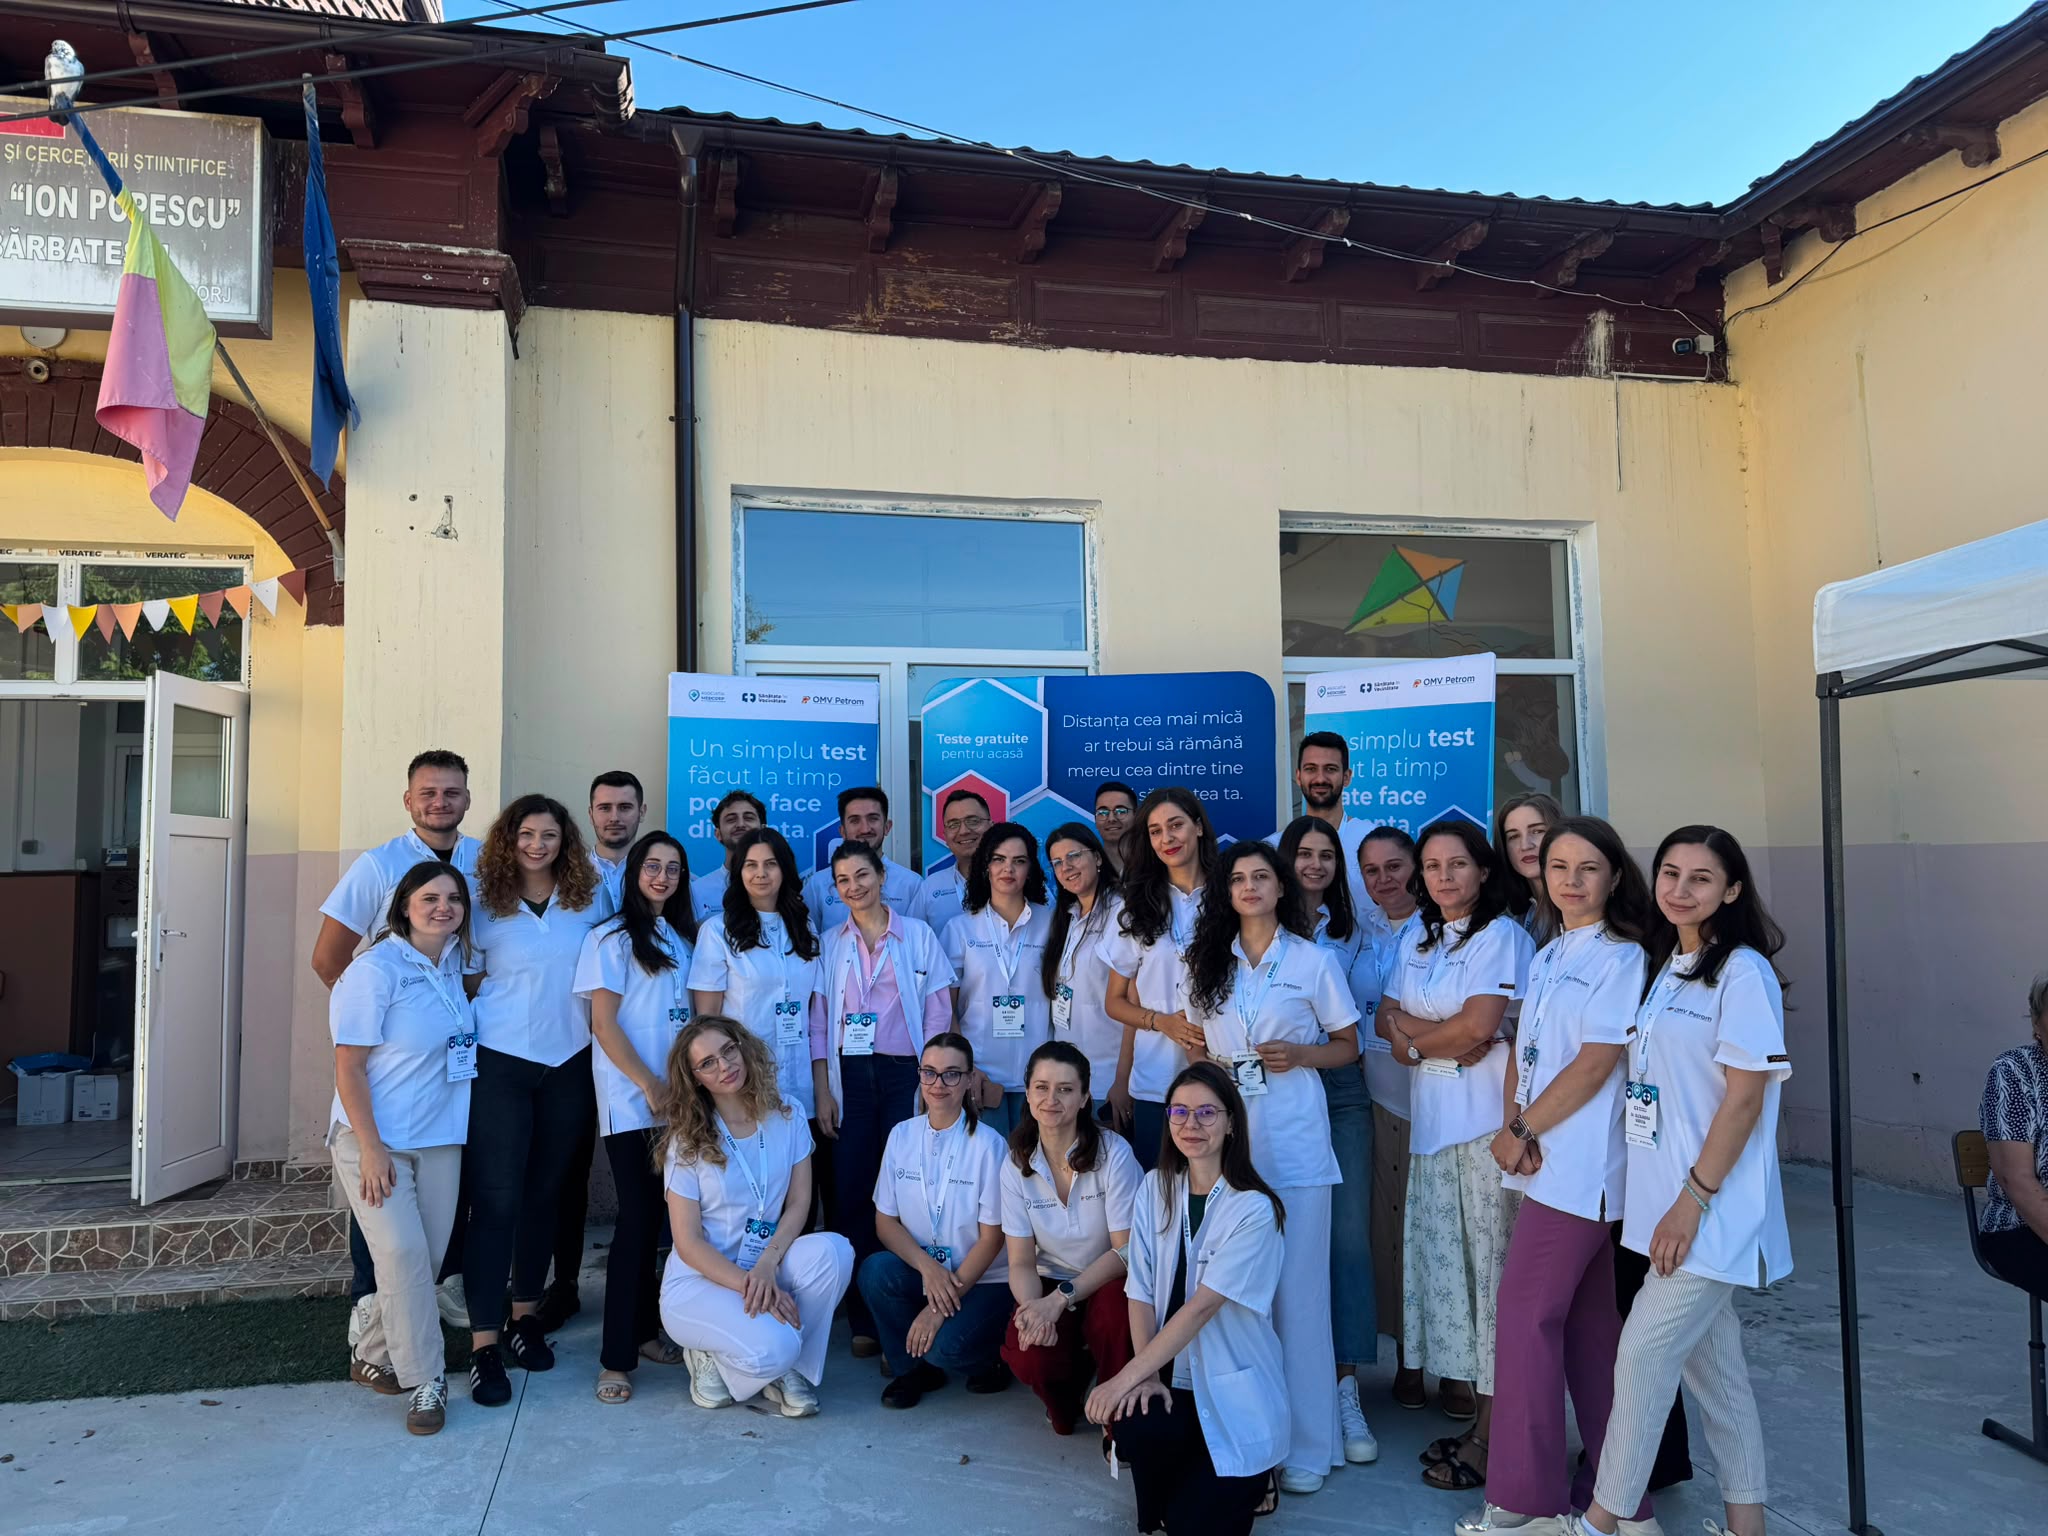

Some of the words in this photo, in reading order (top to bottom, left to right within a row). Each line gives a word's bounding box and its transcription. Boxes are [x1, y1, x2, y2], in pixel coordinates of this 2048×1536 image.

[190, 284, 232, 303] ORJ
[145, 551, 186, 559] VERATEC
[1423, 677, 1444, 687] OMV
[1445, 675, 1475, 685] Petrom
[812, 695, 833, 704] OMV
[834, 696, 865, 705] Petrom
[1063, 714, 1129, 731] Distanța
[1134, 715, 1162, 727] cea
[1166, 711, 1199, 726] mai
[1203, 710, 1243, 725] mică
[936, 733, 973, 746] Teste
[975, 732, 1029, 747] gratuite
[1084, 740, 1100, 753] ar
[1104, 738, 1152, 752] trebui
[1156, 737, 1174, 751] să
[1179, 736, 1243, 750] rămână
[1349, 728, 1421, 754] simplu
[1428, 727, 1475, 747] test
[690, 738, 724, 758] Un
[732, 739, 813, 764] simplu
[820, 742, 867, 761] test
[941, 748, 985, 760] pentru
[987, 747, 1024, 759] acasă
[688, 765, 751, 785] făcut
[760, 766, 778, 786] la
[785, 767, 842, 790] timp
[1068, 765, 1120, 777] mereu
[1125, 765, 1153, 777] cea
[1157, 762, 1207, 776] dintre
[1210, 761, 1244, 775] tine
[1371, 758, 1387, 777] la
[1394, 757, 1448, 781] timp
[770, 793, 821, 812] face
[1223, 788, 1244, 800] ta.
[1379, 785, 1427, 806] face
